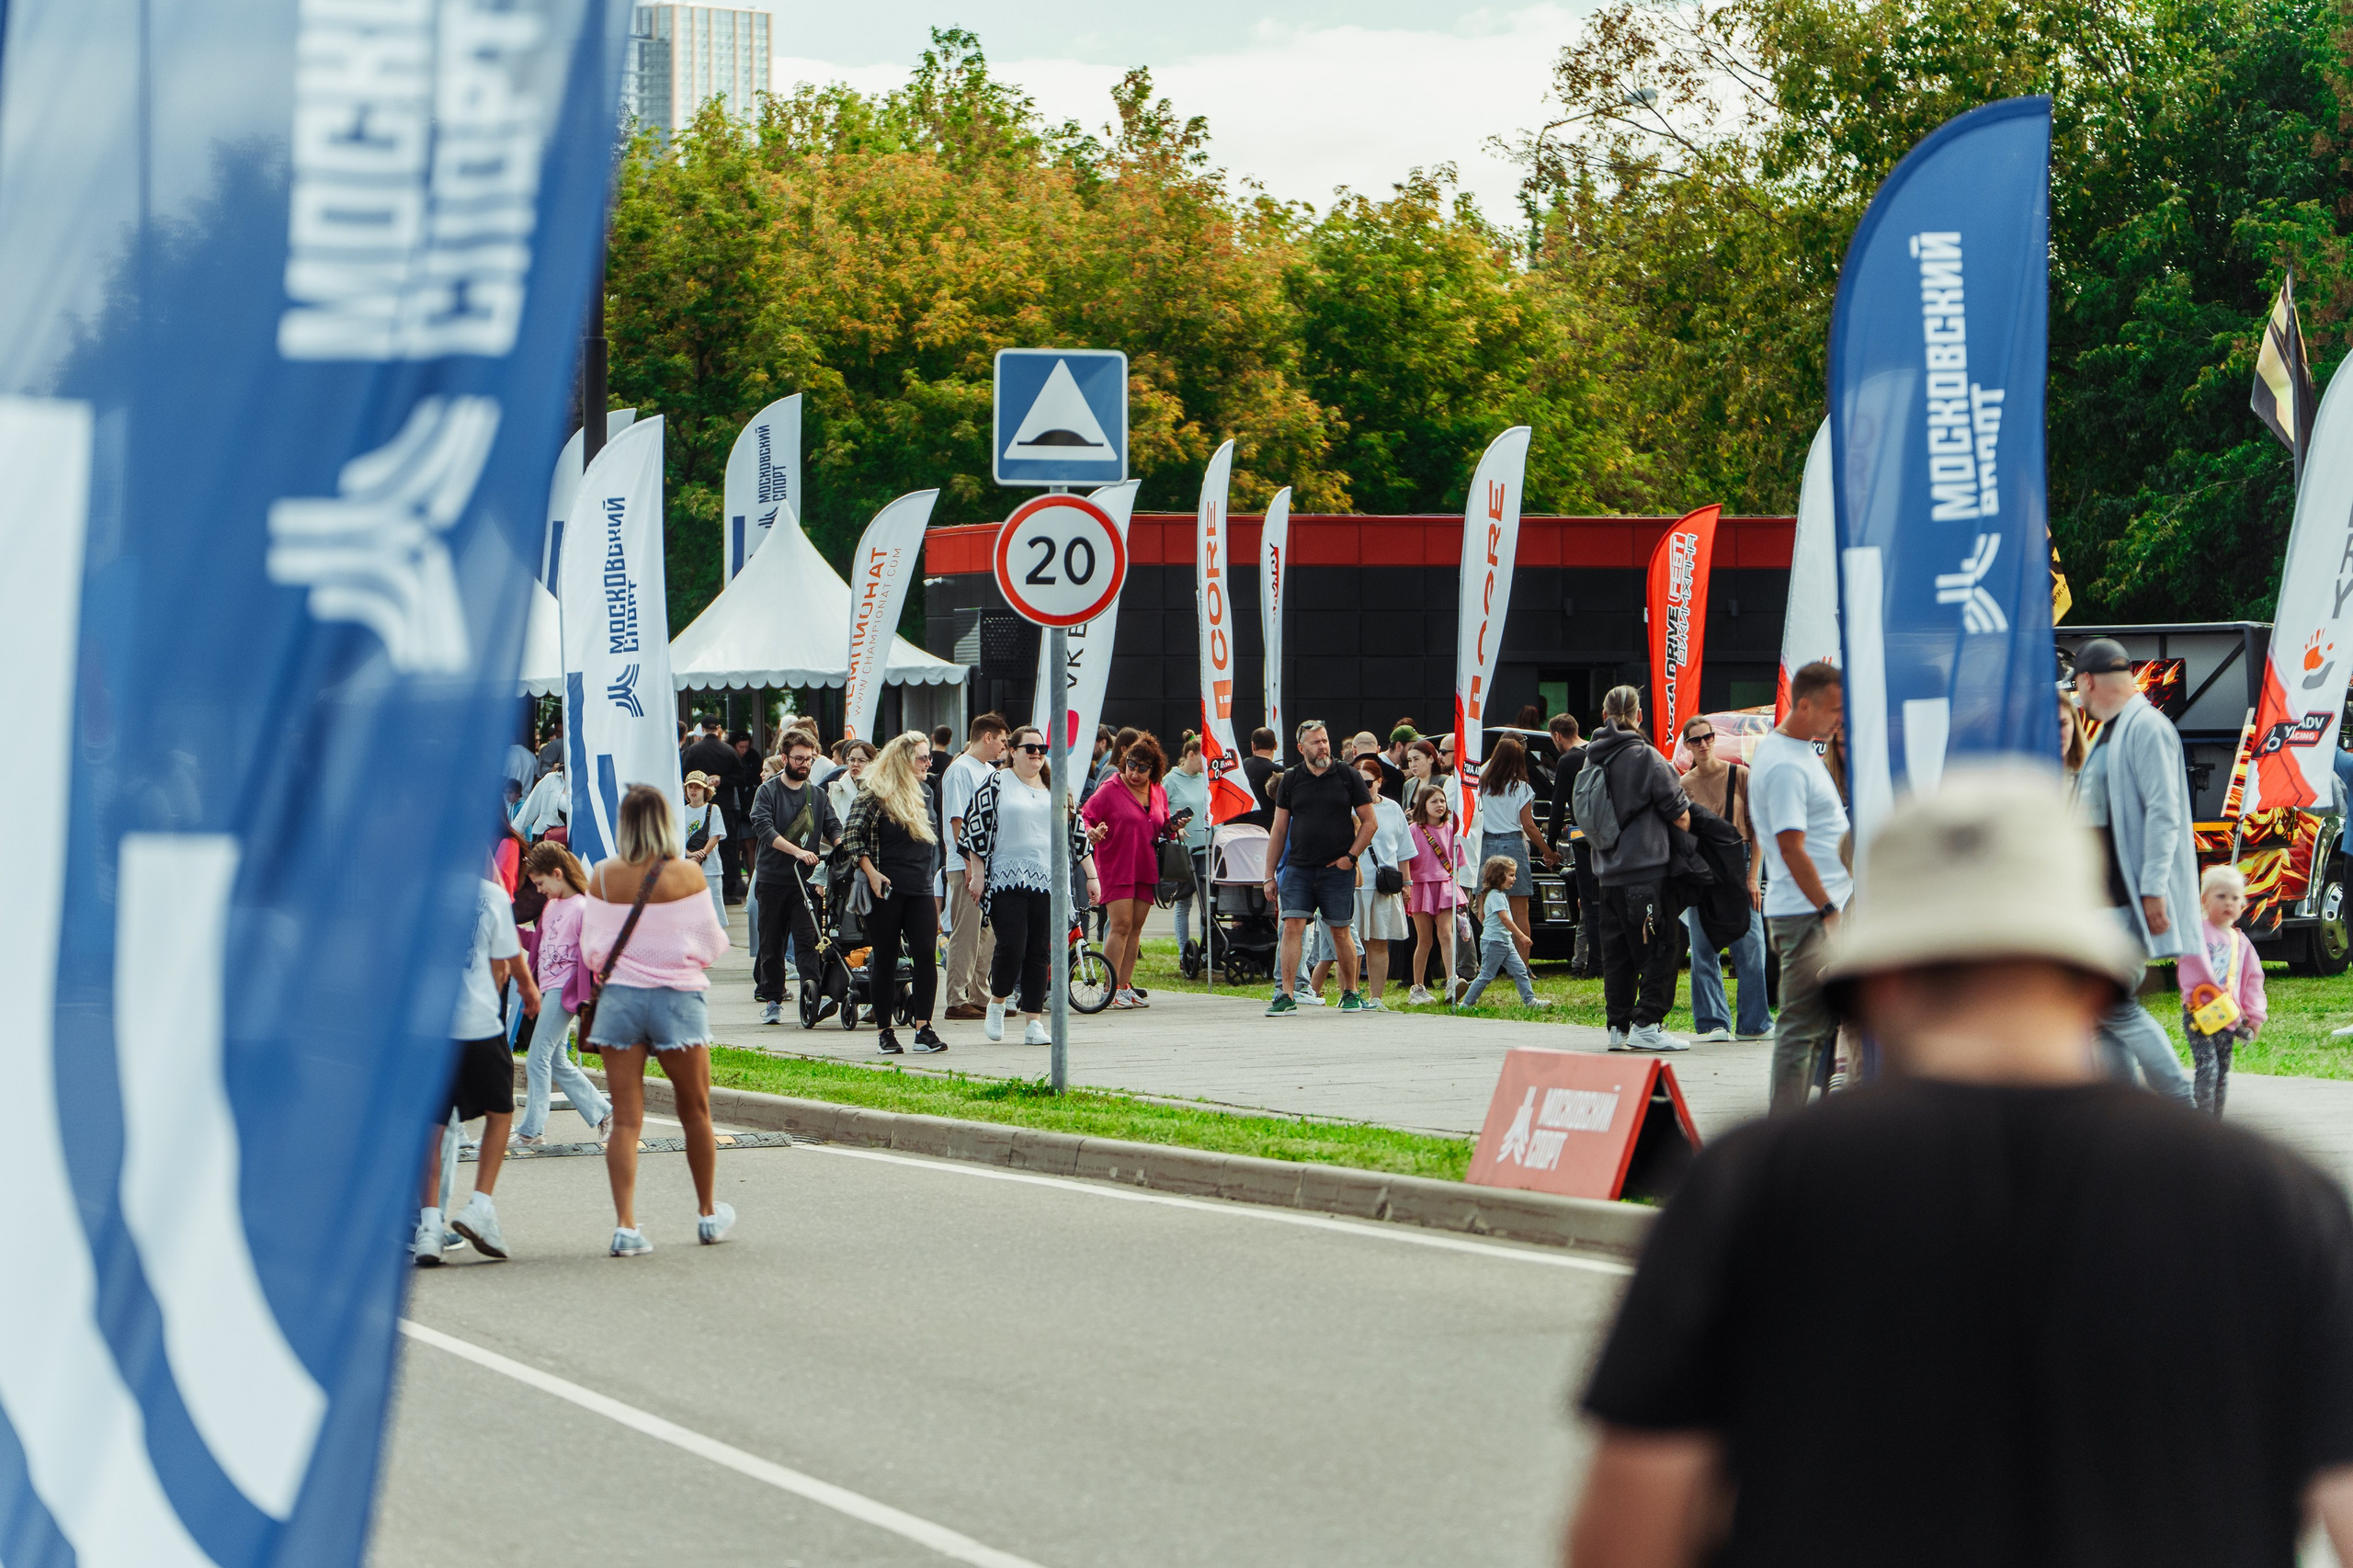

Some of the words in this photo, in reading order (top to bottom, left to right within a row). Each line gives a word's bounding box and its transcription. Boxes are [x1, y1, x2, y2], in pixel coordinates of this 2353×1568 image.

[1909, 231, 1981, 521] МОСКОВСКИЙ
[755, 424, 772, 505] МОСКОВСКИЙ
[771, 464, 787, 502] СПОРТ
[602, 496, 627, 654] МОСКОВСКИЙ
[1025, 536, 1096, 585] 20
[1669, 535, 1686, 598] FEST
[1665, 605, 1679, 678] DRIVE
